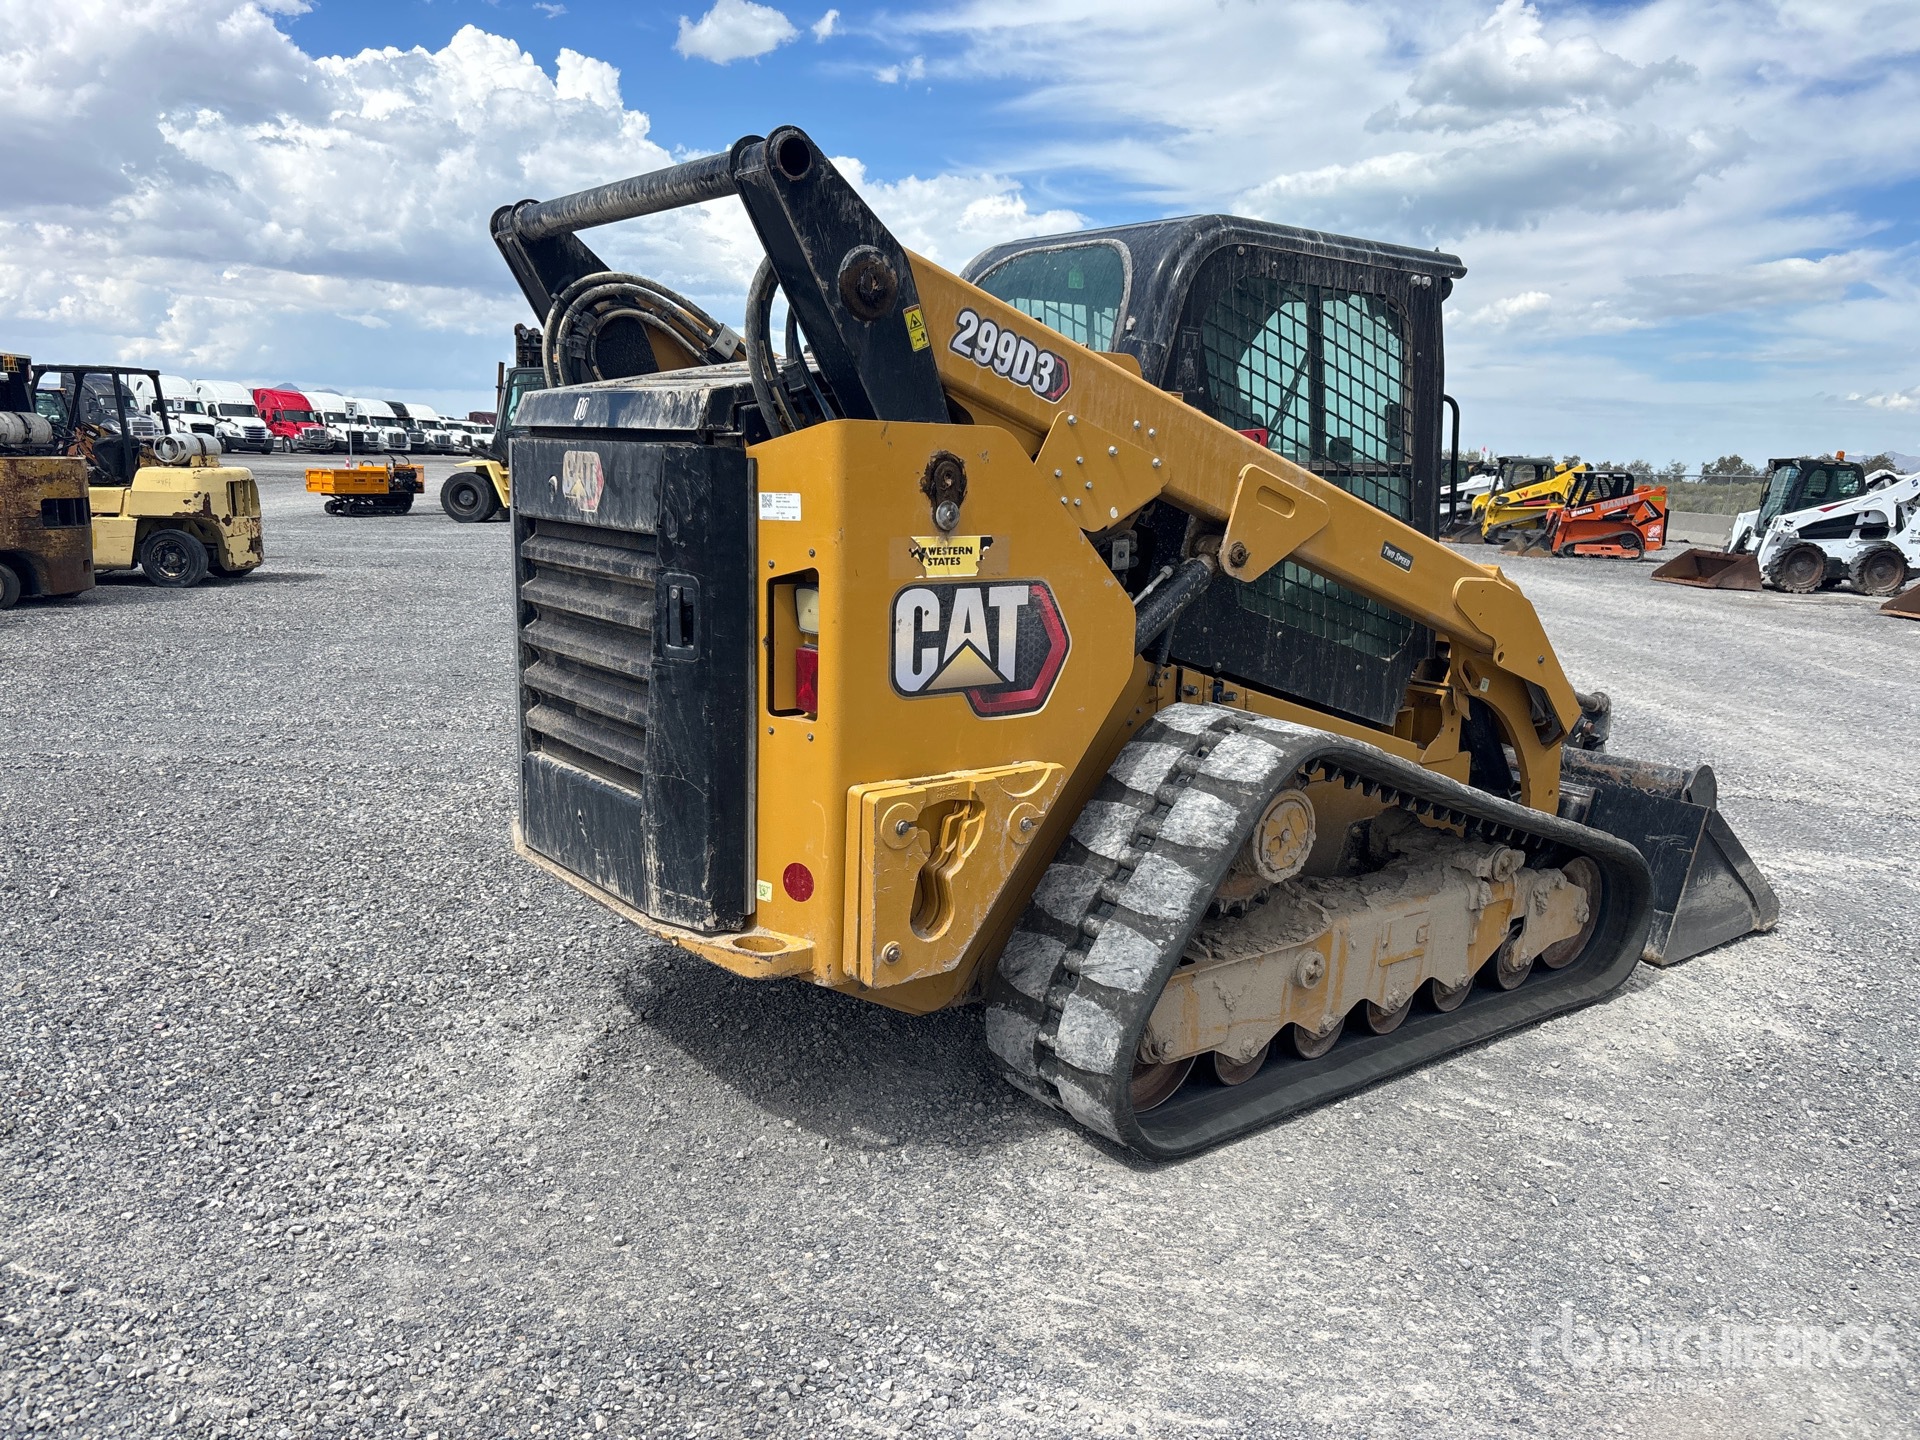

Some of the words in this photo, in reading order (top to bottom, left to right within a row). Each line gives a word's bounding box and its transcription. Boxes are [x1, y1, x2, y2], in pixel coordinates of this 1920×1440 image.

[952, 310, 1055, 393] 299D3
[348, 407, 354, 416] 2
[927, 546, 973, 556] WESTERN
[927, 557, 961, 566] STATES
[895, 586, 1029, 692] CAT
